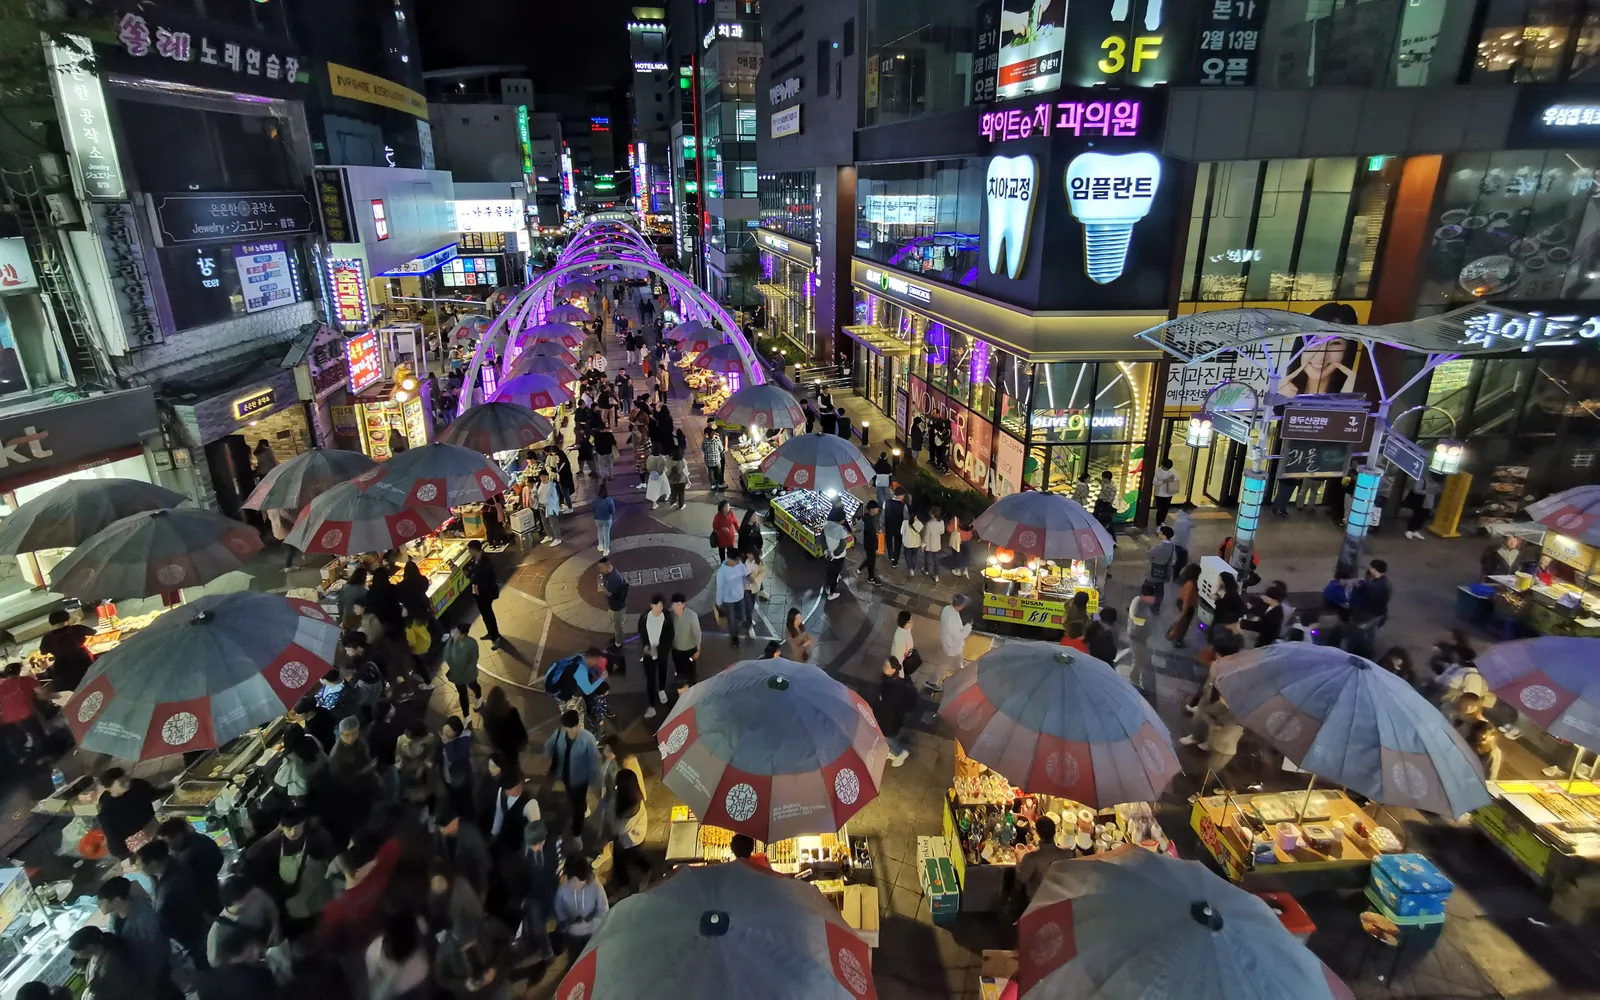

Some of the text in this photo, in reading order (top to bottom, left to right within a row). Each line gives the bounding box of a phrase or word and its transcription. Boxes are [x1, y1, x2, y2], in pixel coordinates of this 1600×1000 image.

[1212, 0, 1256, 20] 본가
[718, 23, 743, 37] 치과
[978, 30, 997, 50] 본가
[1200, 30, 1258, 50] 2월 13일
[200, 37, 299, 83] 노래연습장
[1097, 36, 1163, 73] 3F
[634, 62, 654, 70] HOTEL
[1200, 58, 1249, 86] 오픈
[974, 76, 995, 102] 오픈
[79, 107, 105, 160] 공작소
[987, 176, 1031, 201] 치아교정
[1070, 176, 1153, 201] 임플란트
[251, 201, 277, 216] 공작소
[192, 222, 225, 234] Jewelry
[911, 382, 966, 442] WONDER
[1032, 416, 1068, 428] OLIVE
[1288, 416, 1328, 426] 용두산공원
[0, 425, 53, 469] kt
[77, 457, 111, 472] internet
[1286, 448, 1319, 472] 괴물
